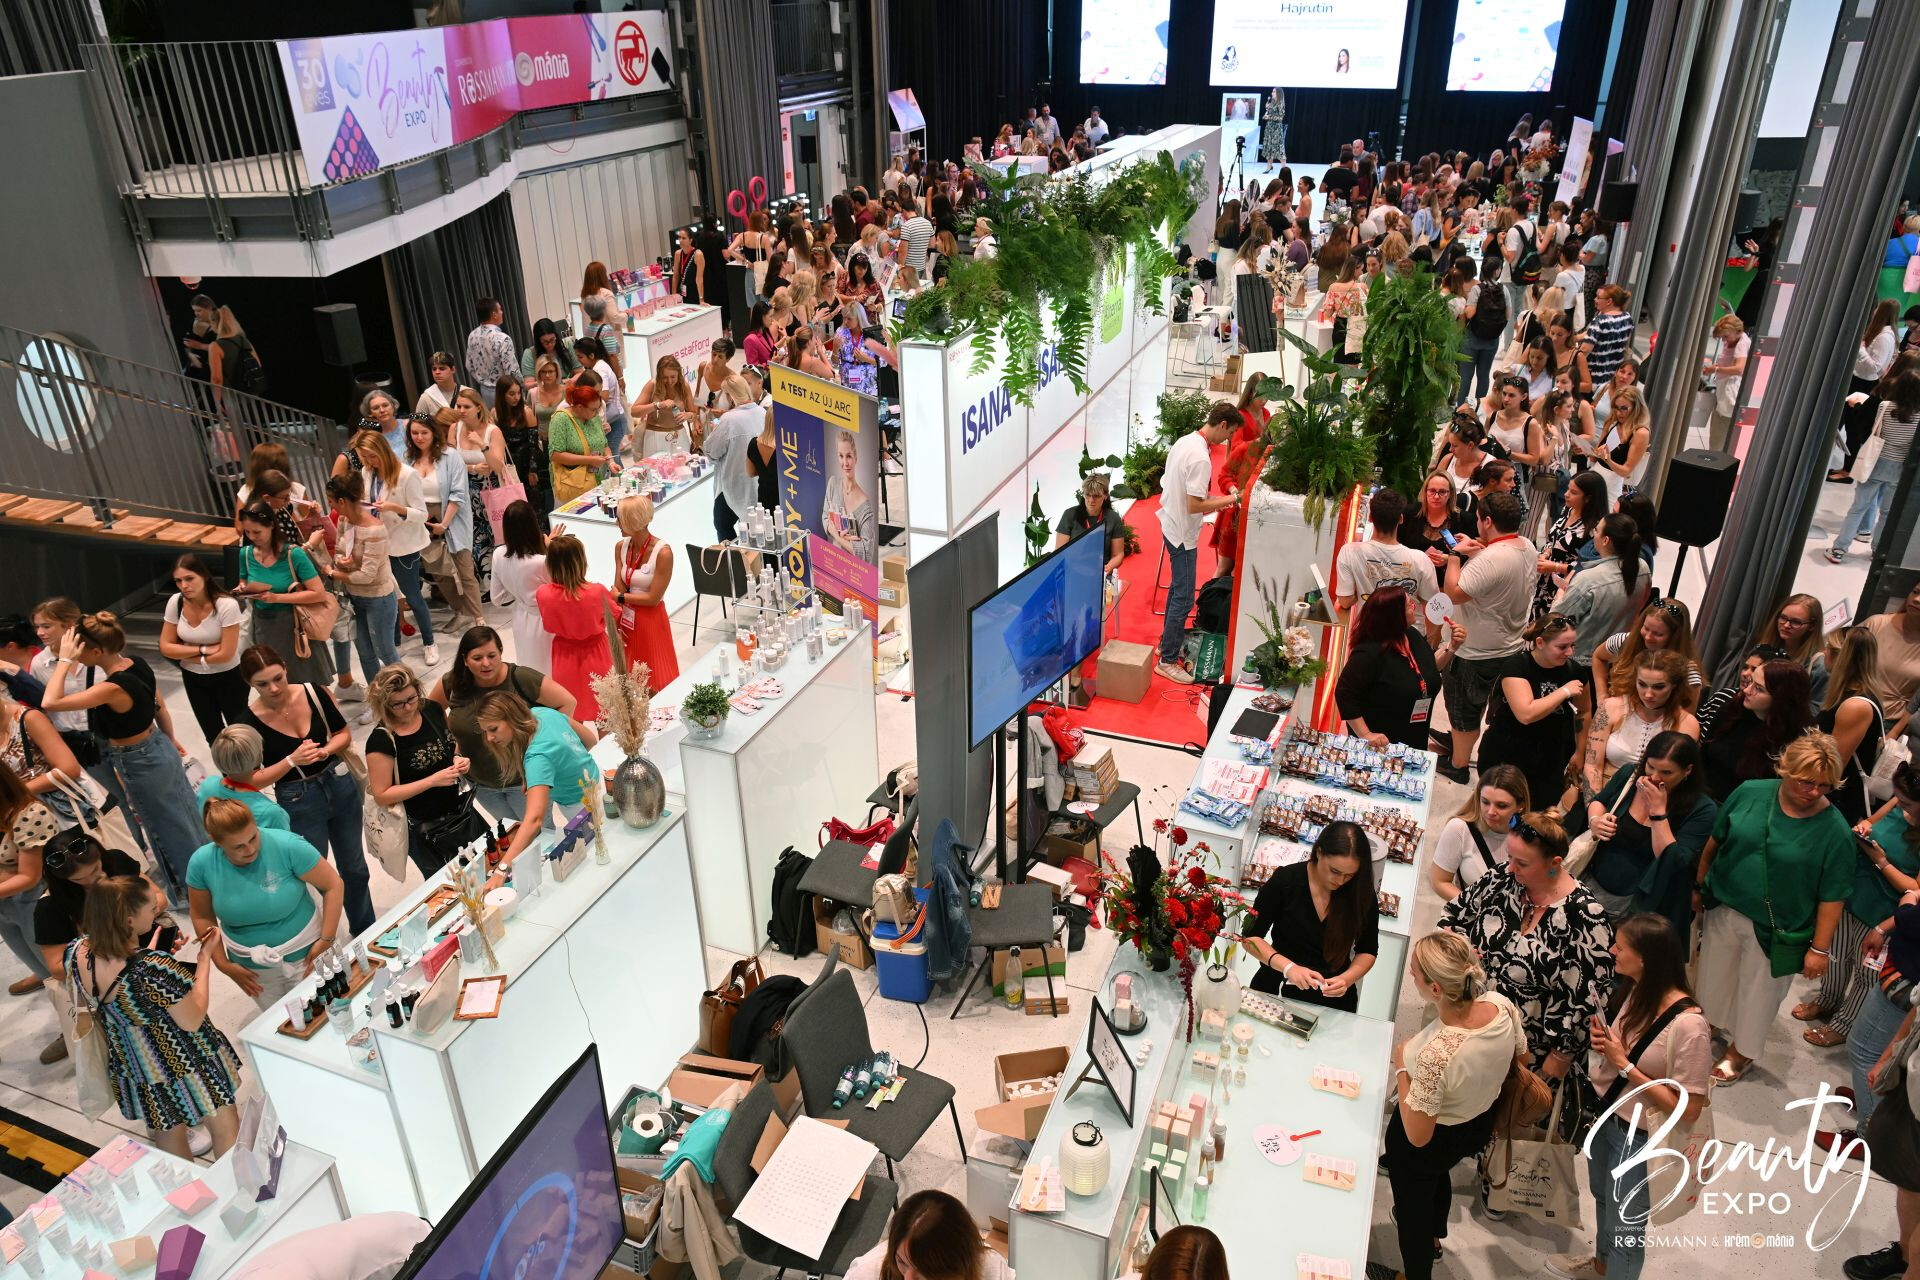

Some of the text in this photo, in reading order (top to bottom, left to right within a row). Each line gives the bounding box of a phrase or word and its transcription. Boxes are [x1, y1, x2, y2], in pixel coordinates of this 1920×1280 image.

[1280, 2, 1334, 15] Hajrutin
[296, 58, 326, 90] 30
[366, 40, 441, 144] Beauty
[404, 110, 427, 127] EXPO
[680, 337, 710, 358] stafford
[780, 380, 787, 392] A
[788, 383, 807, 399] TEST
[809, 392, 821, 404] AZ
[834, 400, 851, 415] ARC
[962, 385, 1012, 456] ISANA
